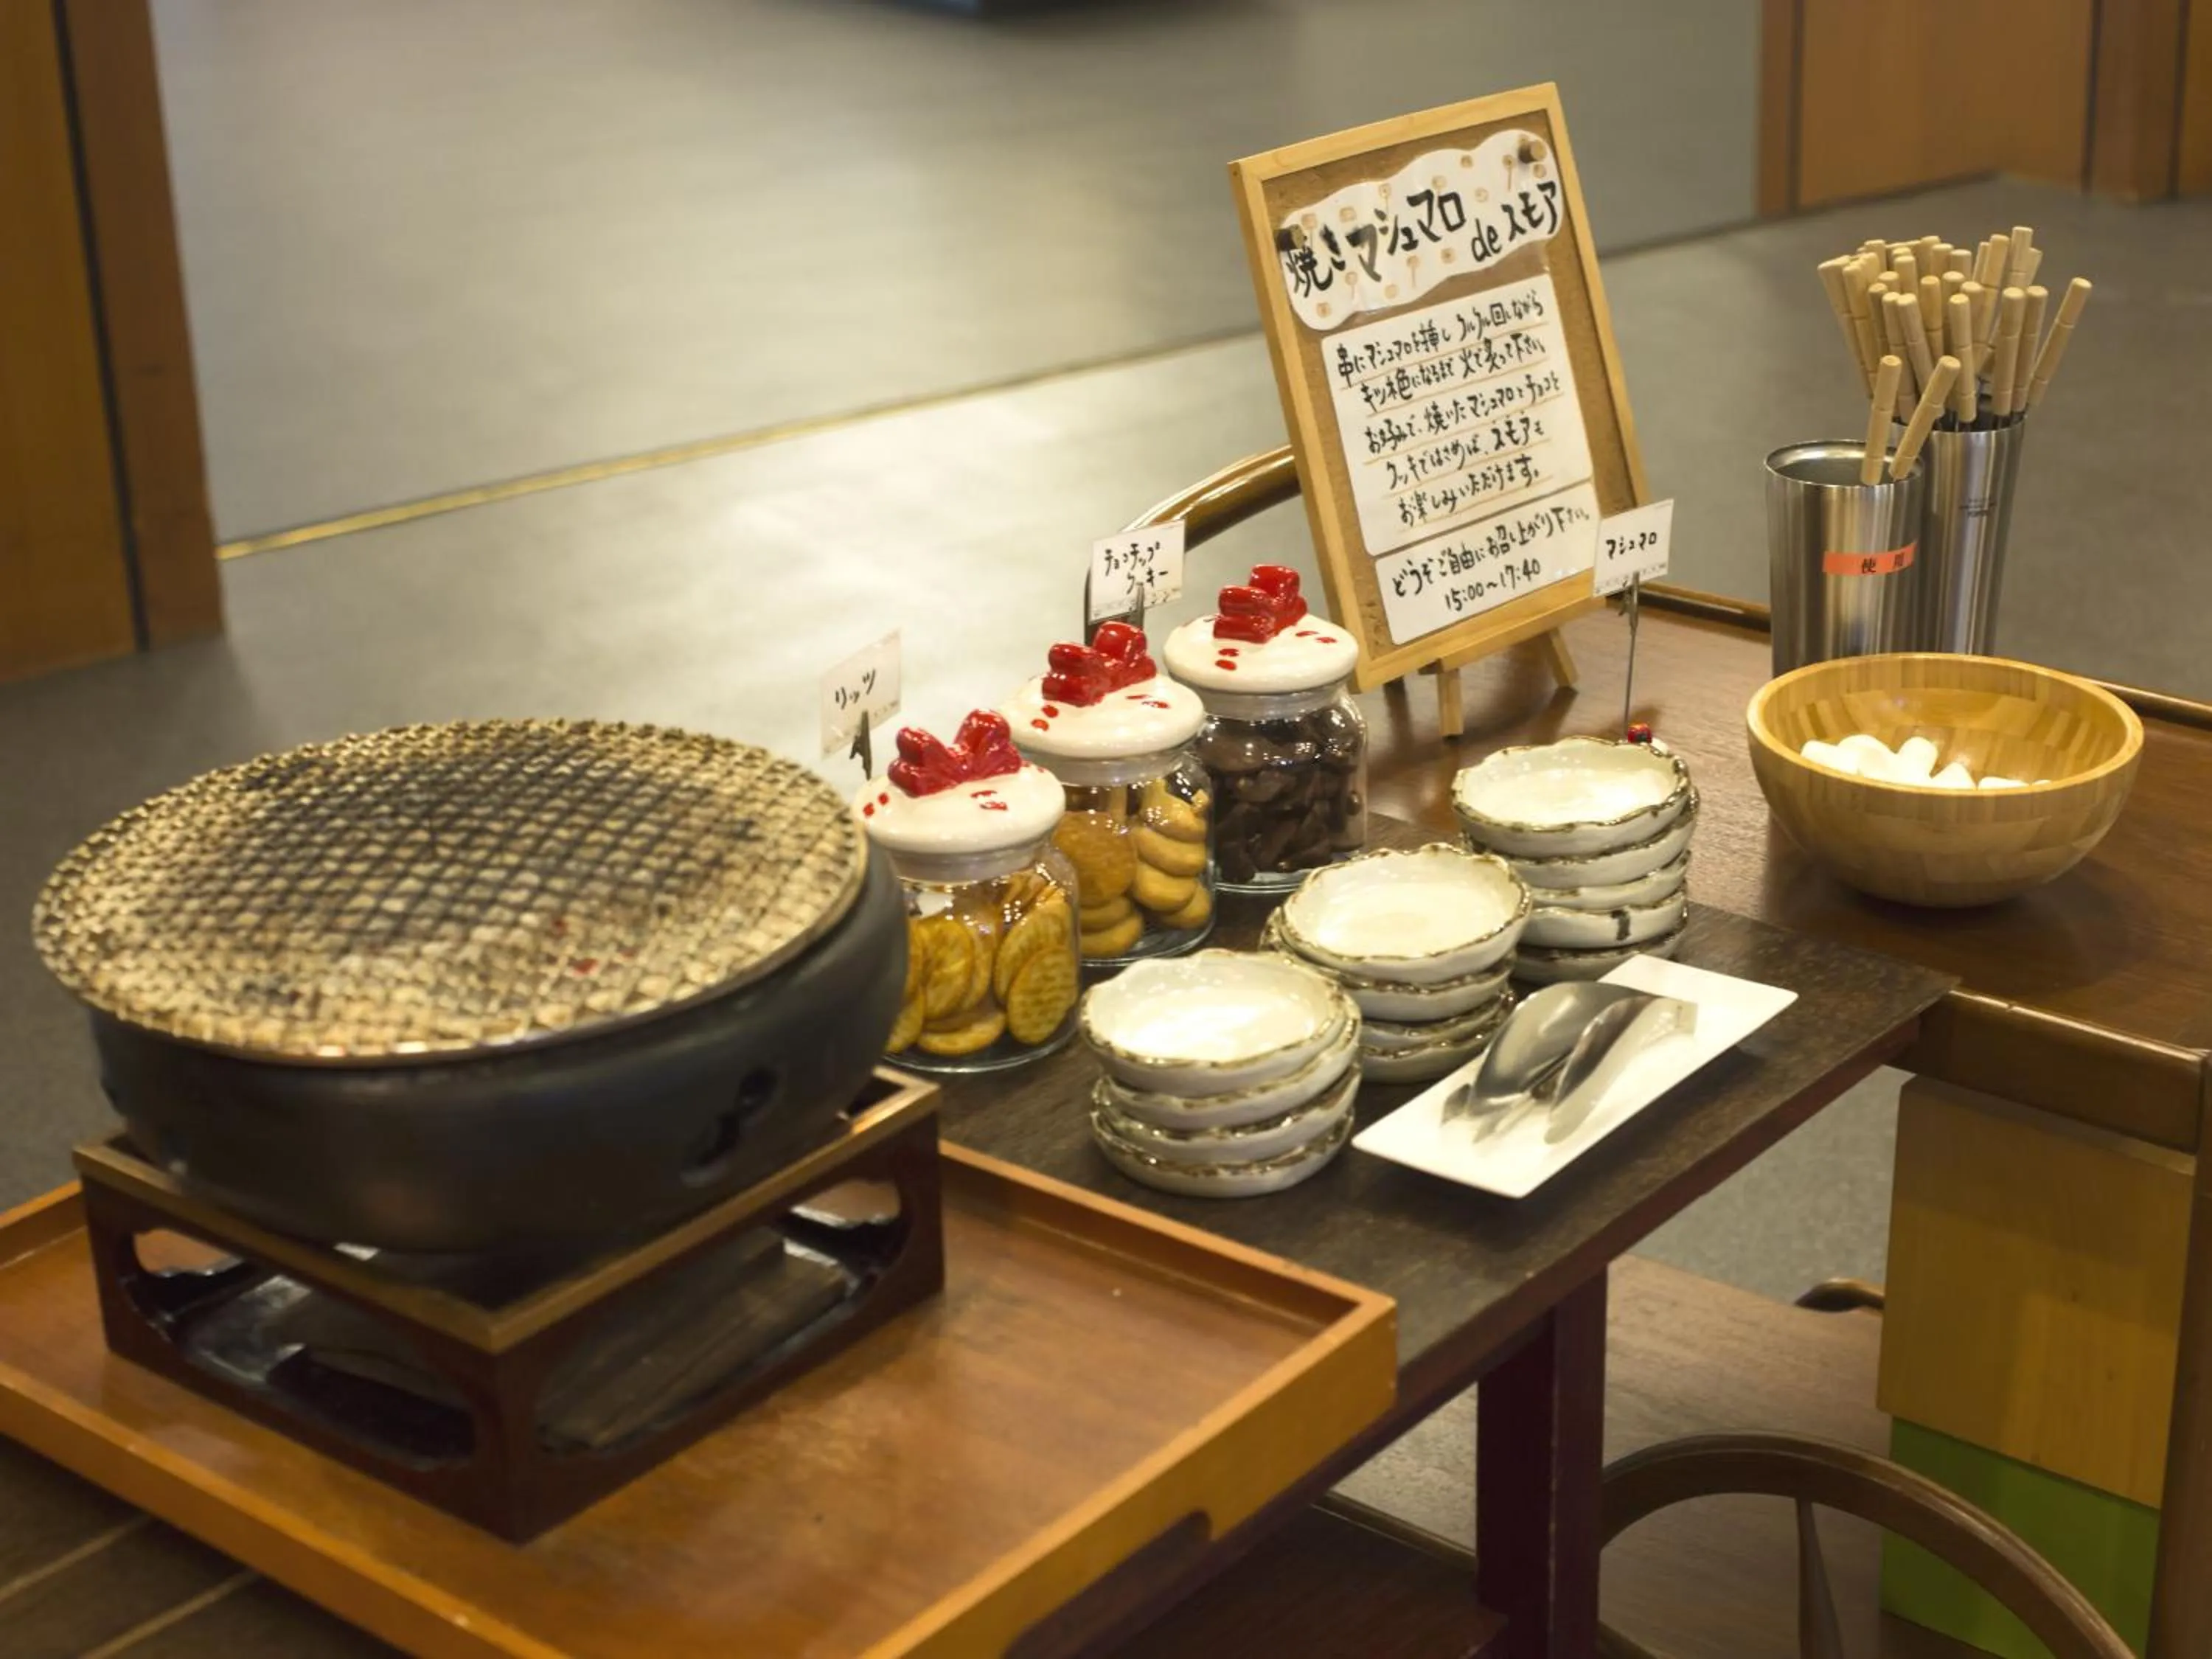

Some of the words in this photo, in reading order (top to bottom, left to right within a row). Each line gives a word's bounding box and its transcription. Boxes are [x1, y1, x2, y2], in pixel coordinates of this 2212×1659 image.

[1605, 531, 1658, 560] マシュマロ
[835, 668, 877, 711] リッツ
